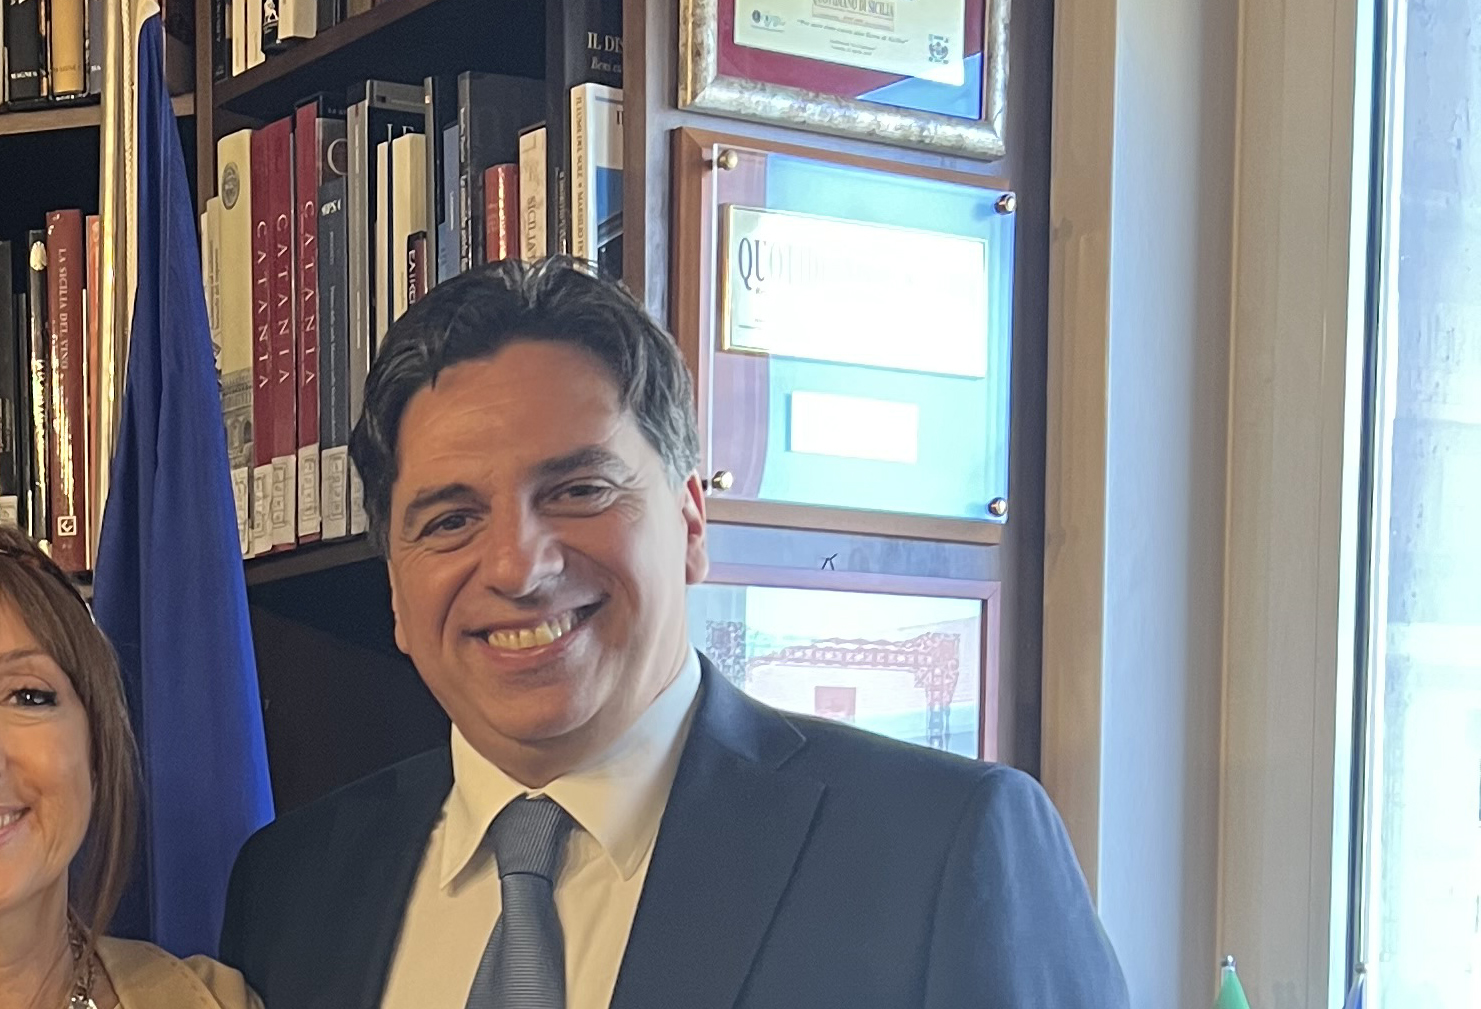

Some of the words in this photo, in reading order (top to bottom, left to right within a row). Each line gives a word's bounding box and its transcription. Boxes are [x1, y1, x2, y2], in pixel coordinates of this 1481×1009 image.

[58, 248, 67, 263] LA
[58, 269, 68, 310] SICILIA
[256, 220, 269, 389] CATANIA
[277, 213, 290, 384] CATANIA
[303, 200, 316, 384] CATANIA
[59, 313, 69, 337] DEL
